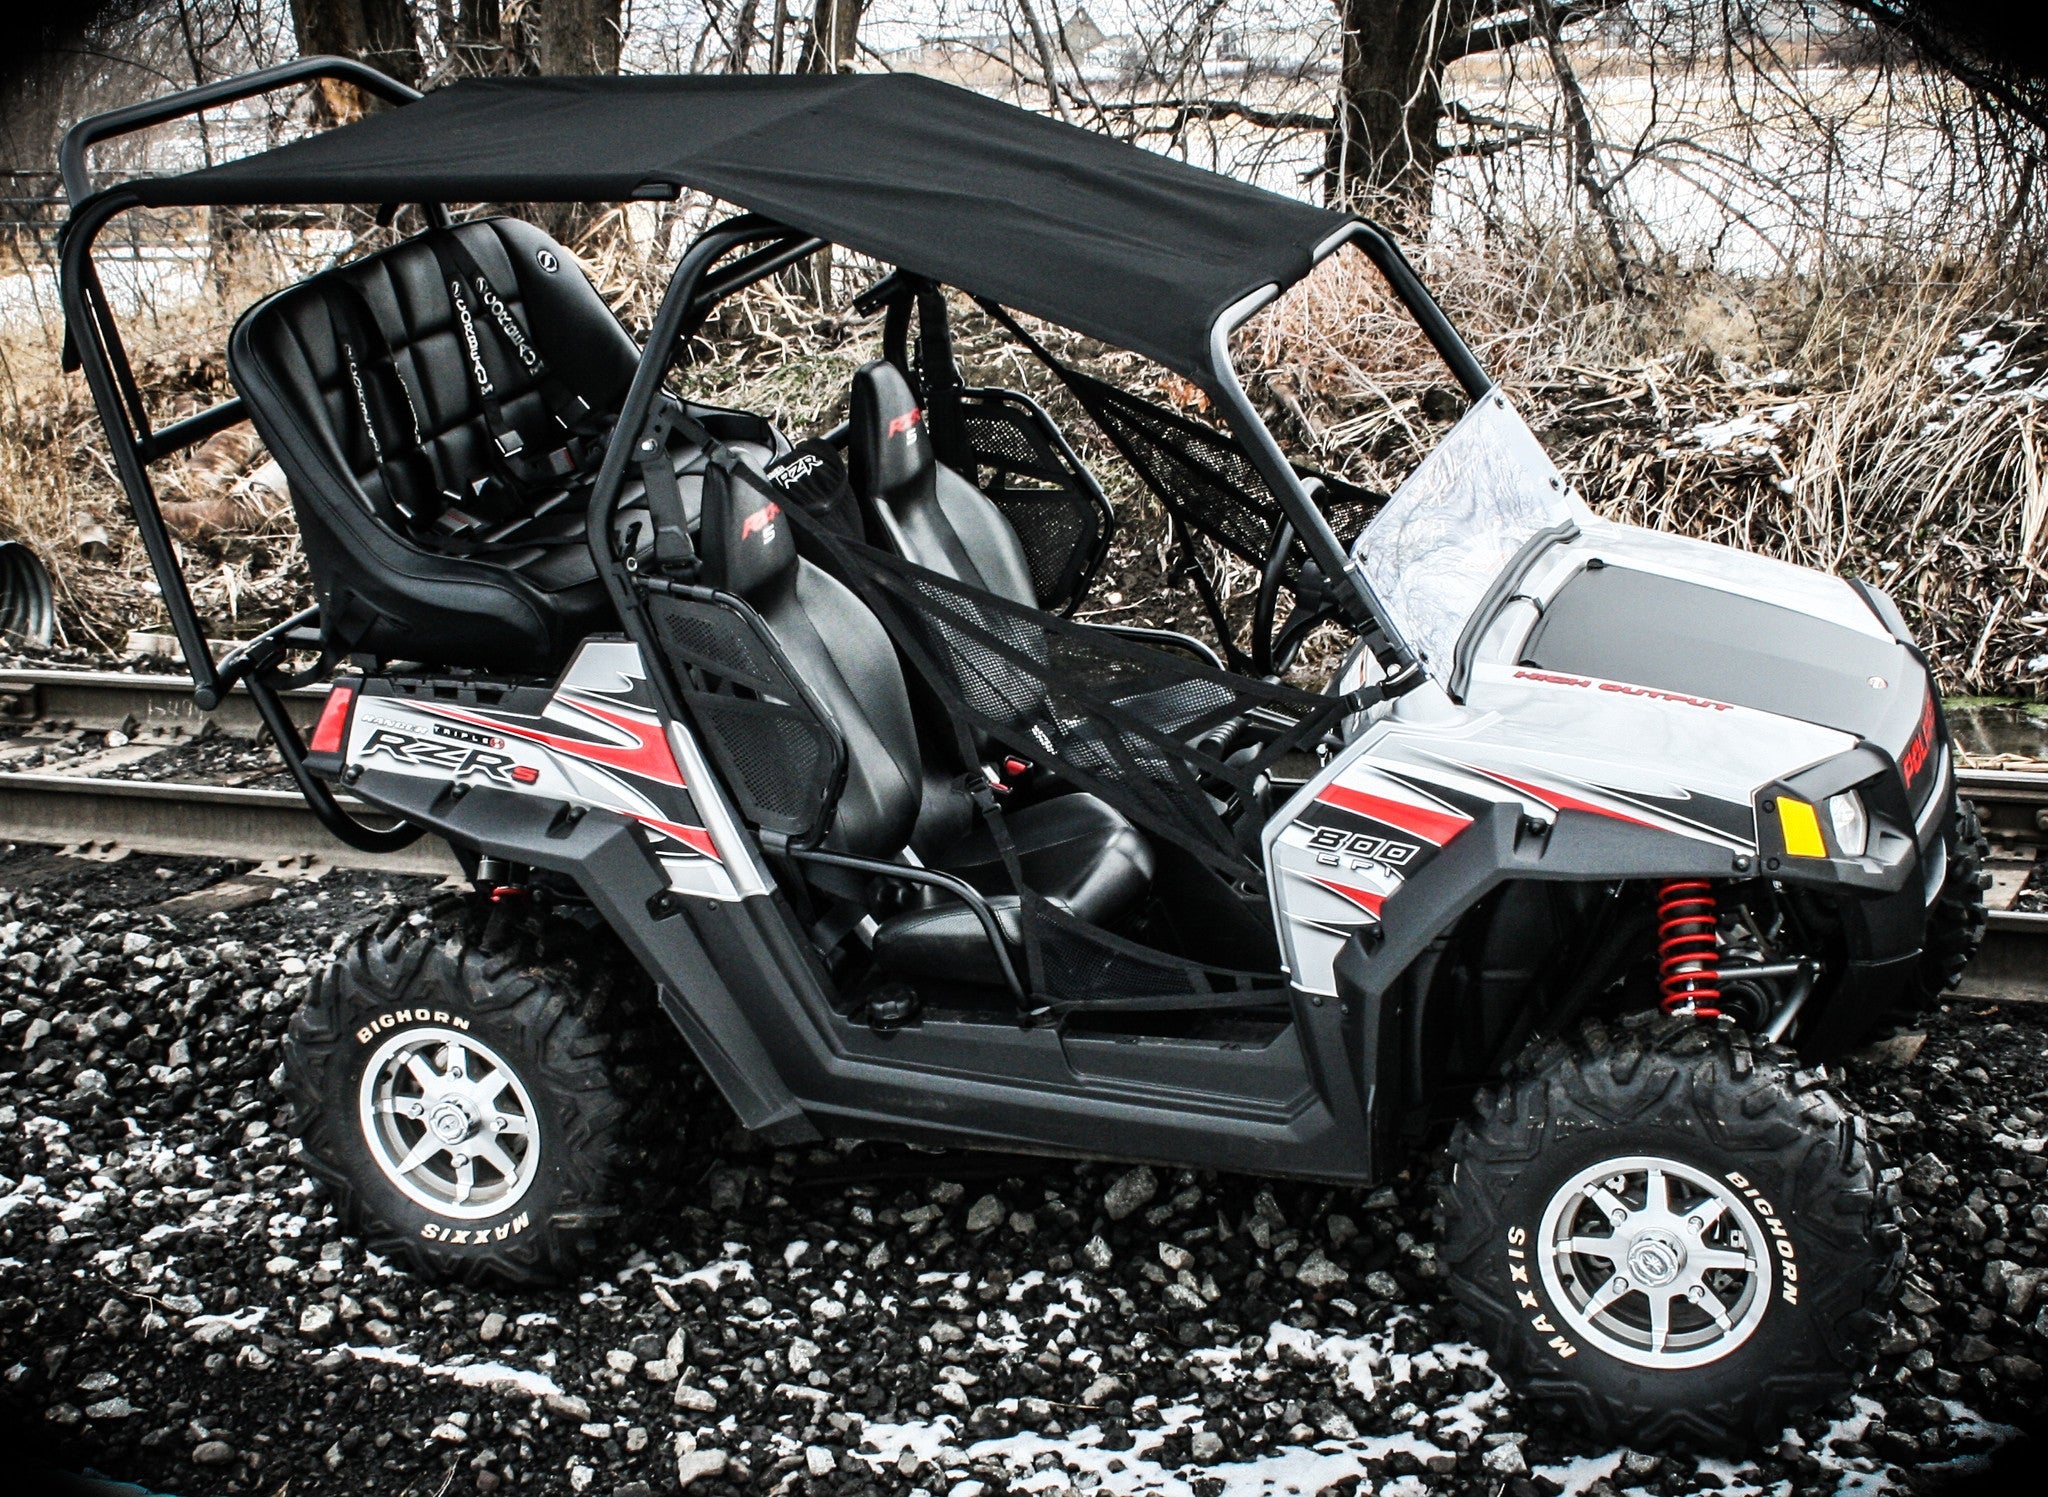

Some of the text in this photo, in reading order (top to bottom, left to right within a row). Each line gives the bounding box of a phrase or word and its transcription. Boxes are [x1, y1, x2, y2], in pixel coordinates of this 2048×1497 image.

[456, 299, 487, 384] CORBEAU
[484, 292, 536, 366] CORBEAU
[776, 454, 823, 489] RZR
[1513, 671, 1734, 711] HIGH OUTPUT
[1307, 826, 1421, 866] 800
[1316, 851, 1392, 878] EFI
[356, 1008, 470, 1044] BIGHORN
[421, 1211, 530, 1245] MAXXIS
[1724, 1171, 1798, 1305] BIGHORN
[1507, 1225, 1577, 1359] MAXXIS
